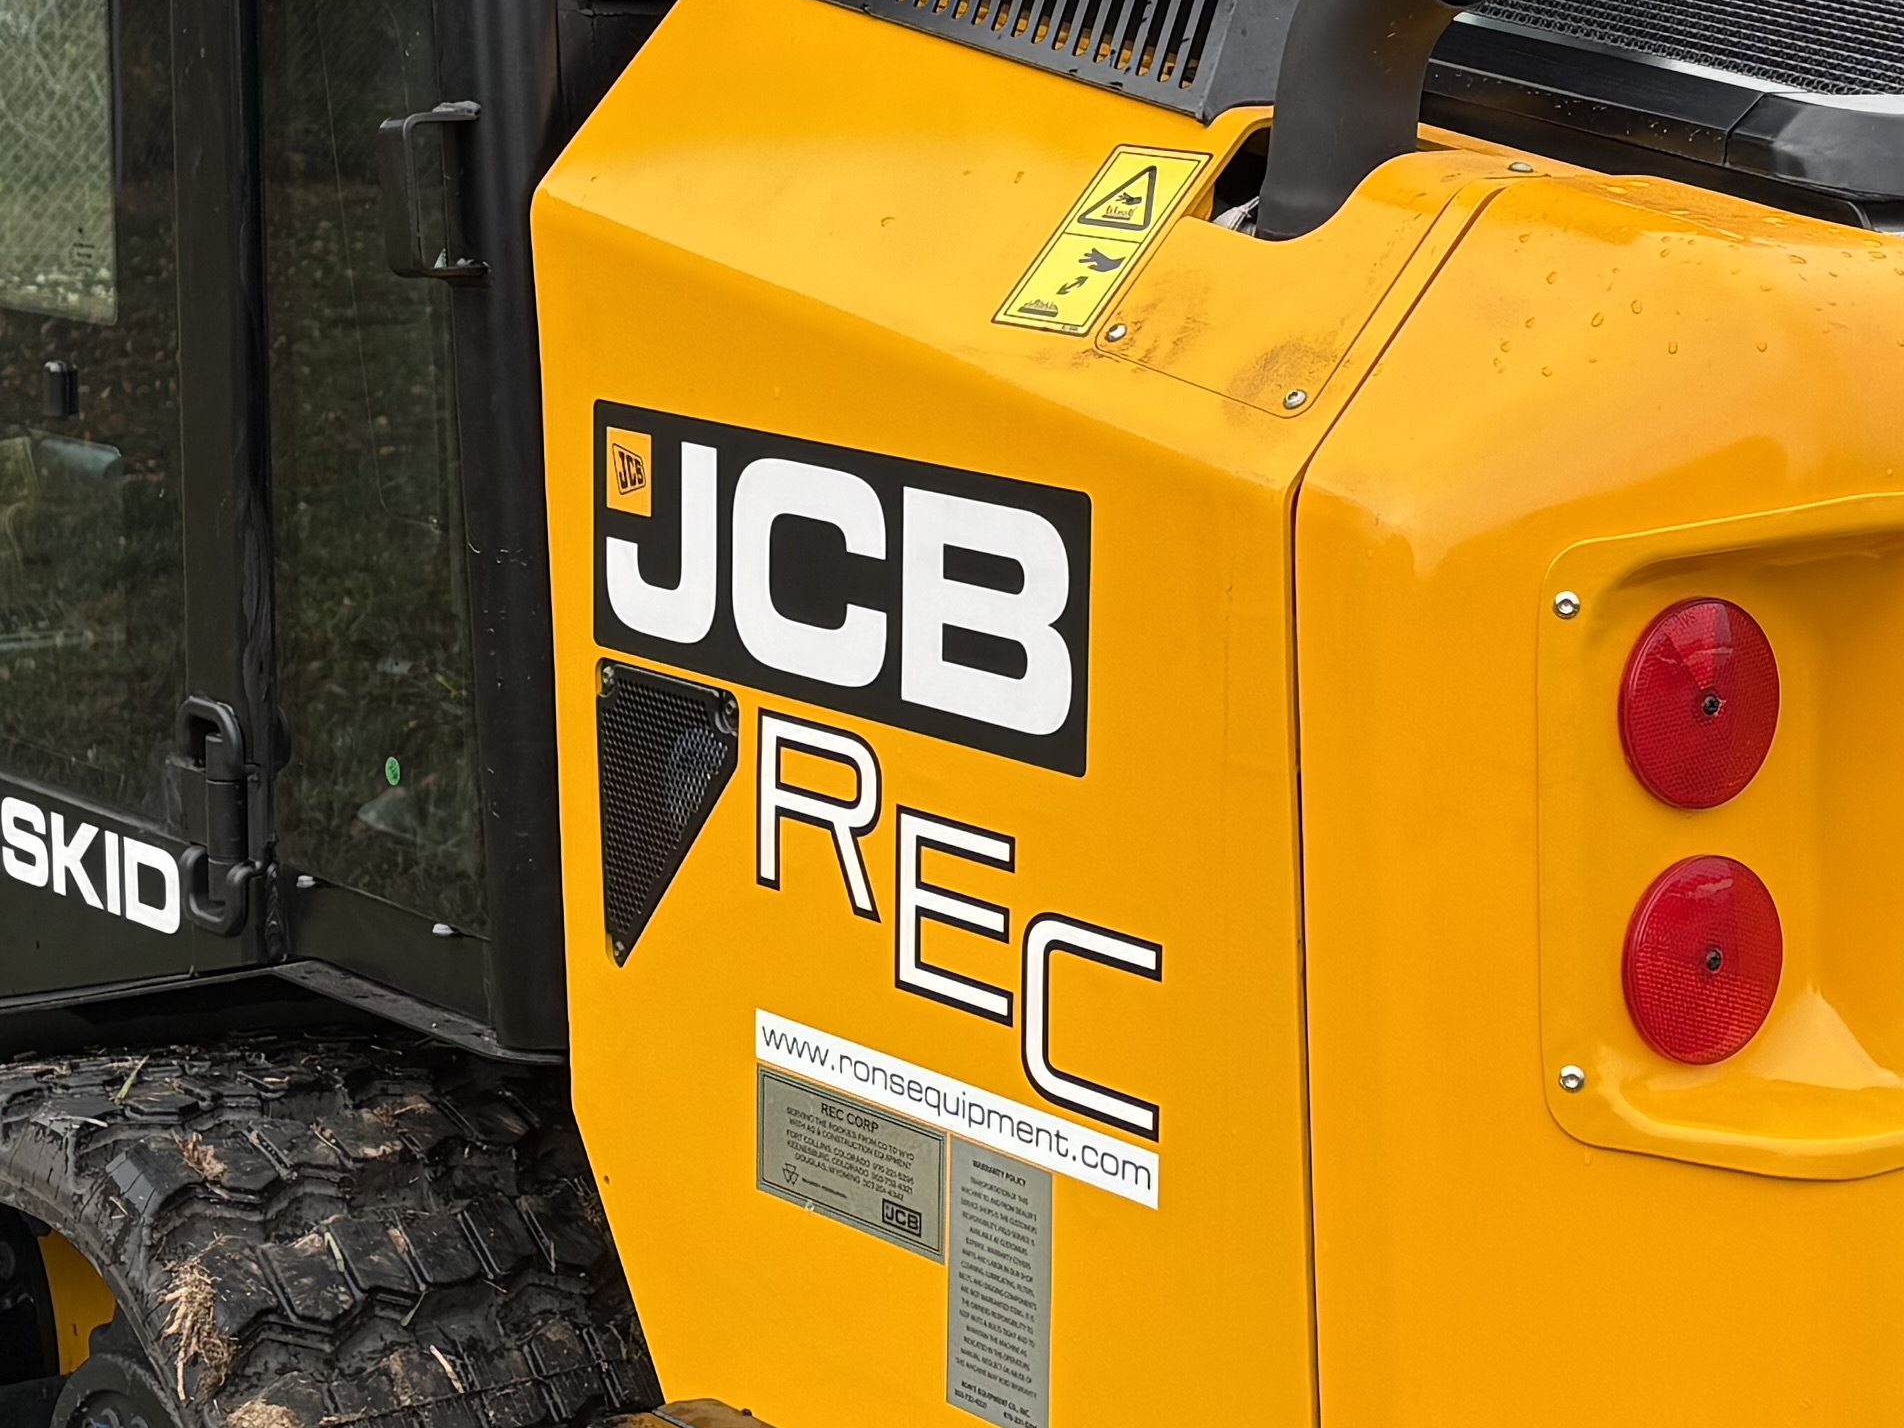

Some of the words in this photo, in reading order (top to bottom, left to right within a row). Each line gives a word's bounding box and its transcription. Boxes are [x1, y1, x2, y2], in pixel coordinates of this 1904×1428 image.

[617, 448, 645, 490] JCB
[606, 441, 1072, 736] JCB
[757, 708, 1162, 1143] REC
[762, 1025, 1151, 1190] www.ronsequipment.com
[821, 1103, 844, 1121] REC
[847, 1113, 879, 1135] CORP
[885, 1204, 919, 1232] JCB
